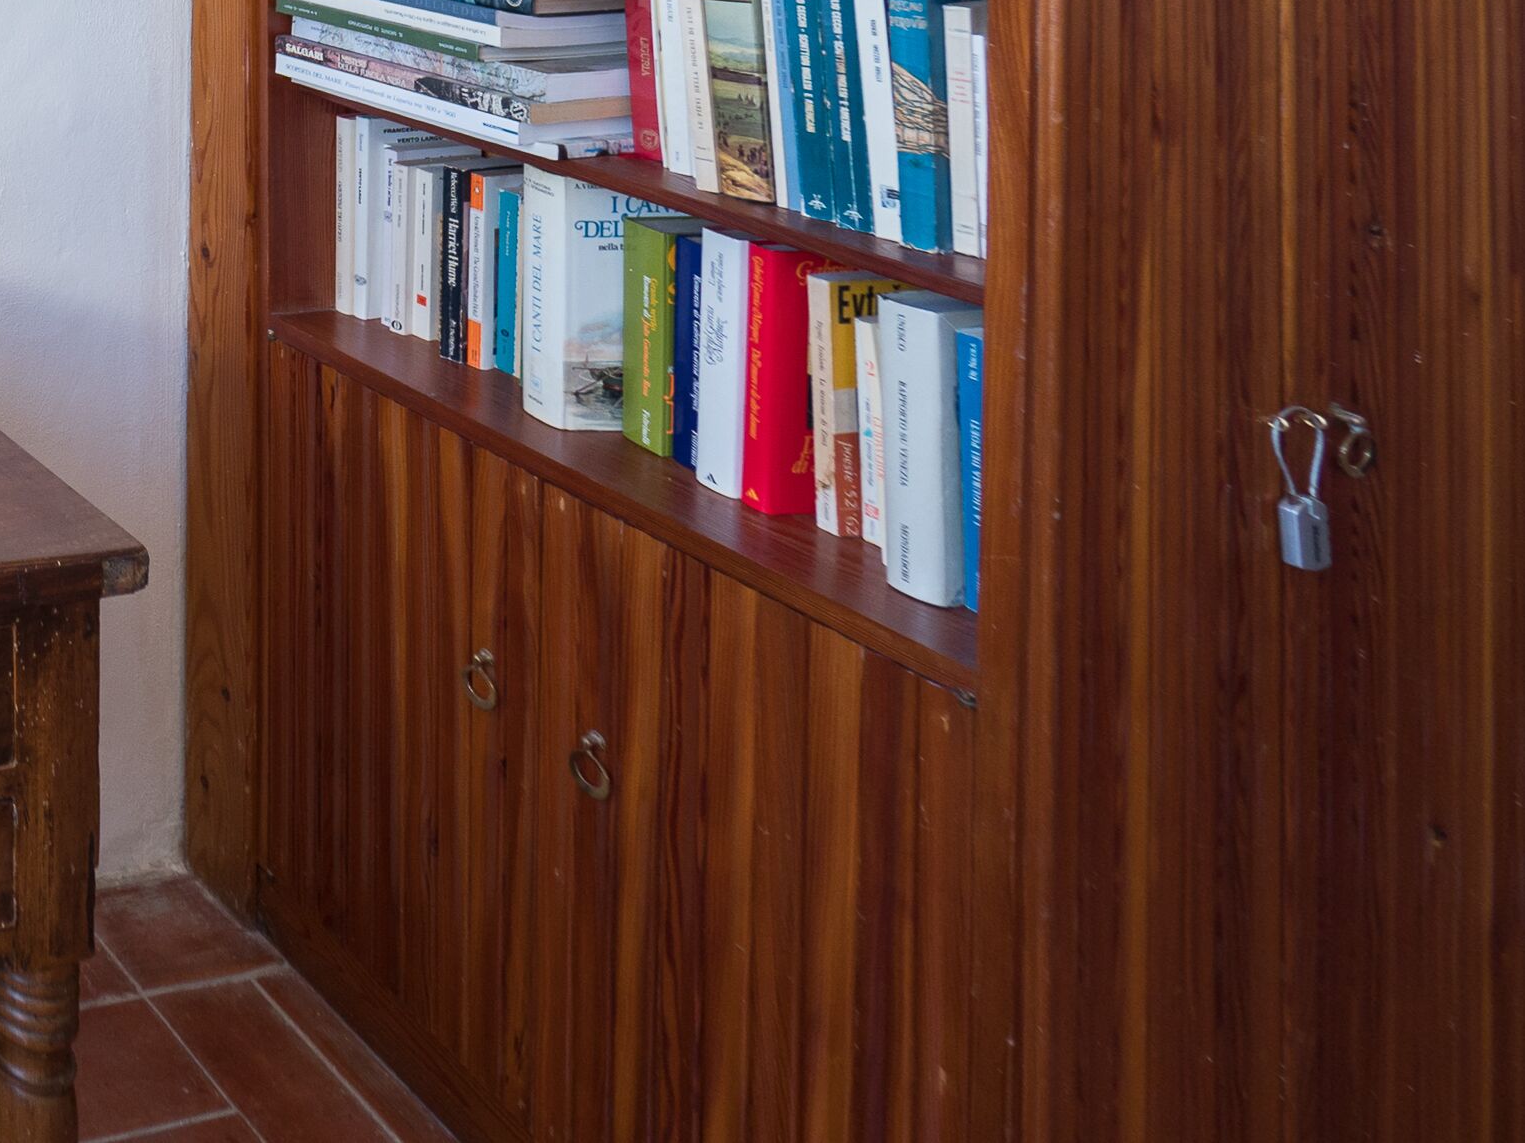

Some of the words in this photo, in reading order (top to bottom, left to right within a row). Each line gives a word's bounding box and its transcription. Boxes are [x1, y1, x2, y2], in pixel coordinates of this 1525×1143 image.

[666, 0, 674, 22] LIGURI
[686, 6, 694, 24] LUNI
[796, 5, 807, 27] CECCHI
[831, 11, 842, 34] CECCHI
[348, 20, 372, 31] PORTOFINO
[380, 28, 396, 36] MONTE
[285, 43, 324, 61] SALGARI
[341, 55, 367, 69] MISTERI
[640, 36, 652, 77] LIGURIA
[690, 39, 698, 67] DIOCESI
[798, 34, 811, 65] SCRITTORI
[833, 41, 846, 73] SCRITTORI
[285, 63, 314, 77] SCOPERTA
[313, 71, 325, 80] DEL
[326, 74, 342, 85] MARE
[338, 62, 358, 74] DELLA
[692, 70, 701, 93] DELLA
[801, 67, 813, 90] INGLESI
[837, 74, 848, 98] INGLESI
[694, 97, 704, 114] PIEVI
[803, 98, 815, 133] AMERICANI
[839, 106, 851, 142] AMERICANI
[611, 196, 619, 213] I
[448, 218, 459, 253] Harriet
[532, 215, 542, 256] MARE
[598, 243, 618, 251] nella
[447, 254, 458, 287] Hume
[532, 264, 542, 292] DEL
[753, 255, 764, 283] Gabriel
[642, 275, 651, 310] Romanzo
[650, 278, 659, 306] Grande
[693, 274, 701, 310] Romanzo
[532, 296, 542, 343] CANTI
[642, 310, 650, 319] di
[693, 311, 701, 319] di
[692, 320, 701, 349] Gabriel
[896, 313, 906, 352] UNESCO
[704, 336, 717, 365] Gabriel
[642, 379, 650, 397] Rosa
[749, 398, 760, 415] altri
[897, 380, 908, 431] RAPPORTO
[641, 409, 650, 446] Feltrinelli
[749, 416, 759, 440] demoni
[899, 432, 908, 446] SU
[969, 419, 981, 446] POETI
[837, 441, 856, 483] poesie
[899, 447, 910, 487] VENEZIA
[970, 448, 981, 468] DEI
[843, 486, 858, 508] '52
[971, 470, 981, 506] LIGURIA
[845, 509, 860, 536] '62
[971, 509, 981, 525] LA
[898, 521, 911, 584] MONDADORI
